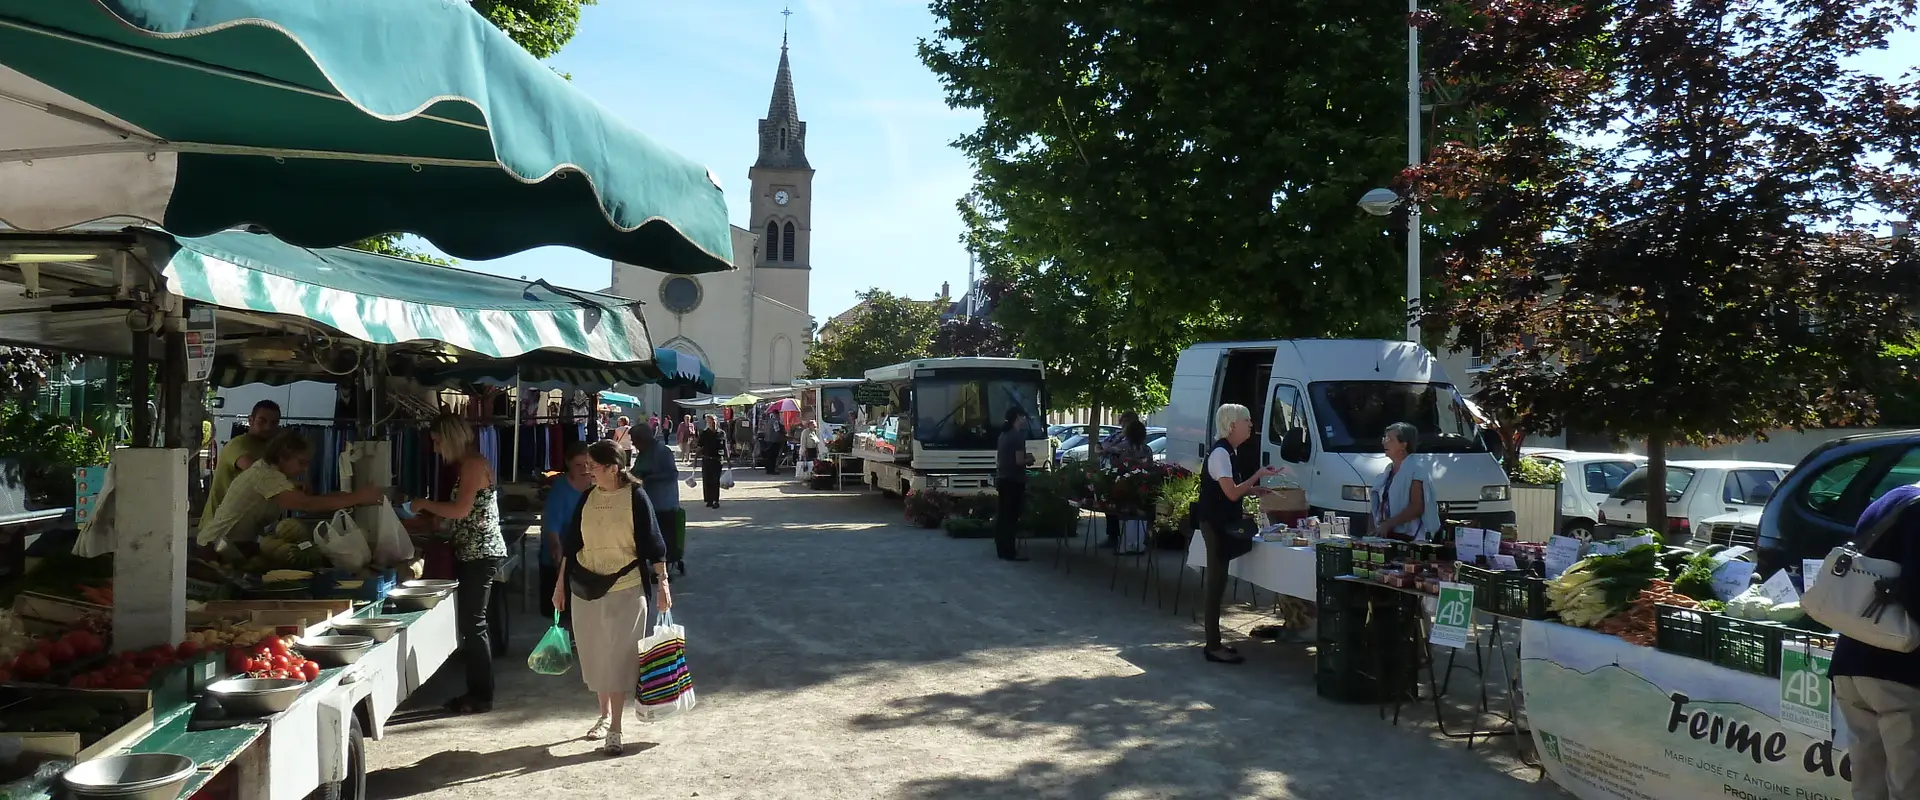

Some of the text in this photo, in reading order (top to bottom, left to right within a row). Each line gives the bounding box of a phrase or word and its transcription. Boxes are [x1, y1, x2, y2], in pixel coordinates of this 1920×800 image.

[1438, 600, 1465, 626] AB
[1784, 669, 1822, 707] AB
[1668, 692, 1786, 764] Ferme
[1781, 703, 1830, 720] AGRICULTURE
[1664, 749, 1694, 766] MARIE
[1696, 760, 1723, 776] JOSÉ
[1726, 769, 1740, 780] ET
[1743, 773, 1792, 796] ANTOINE
